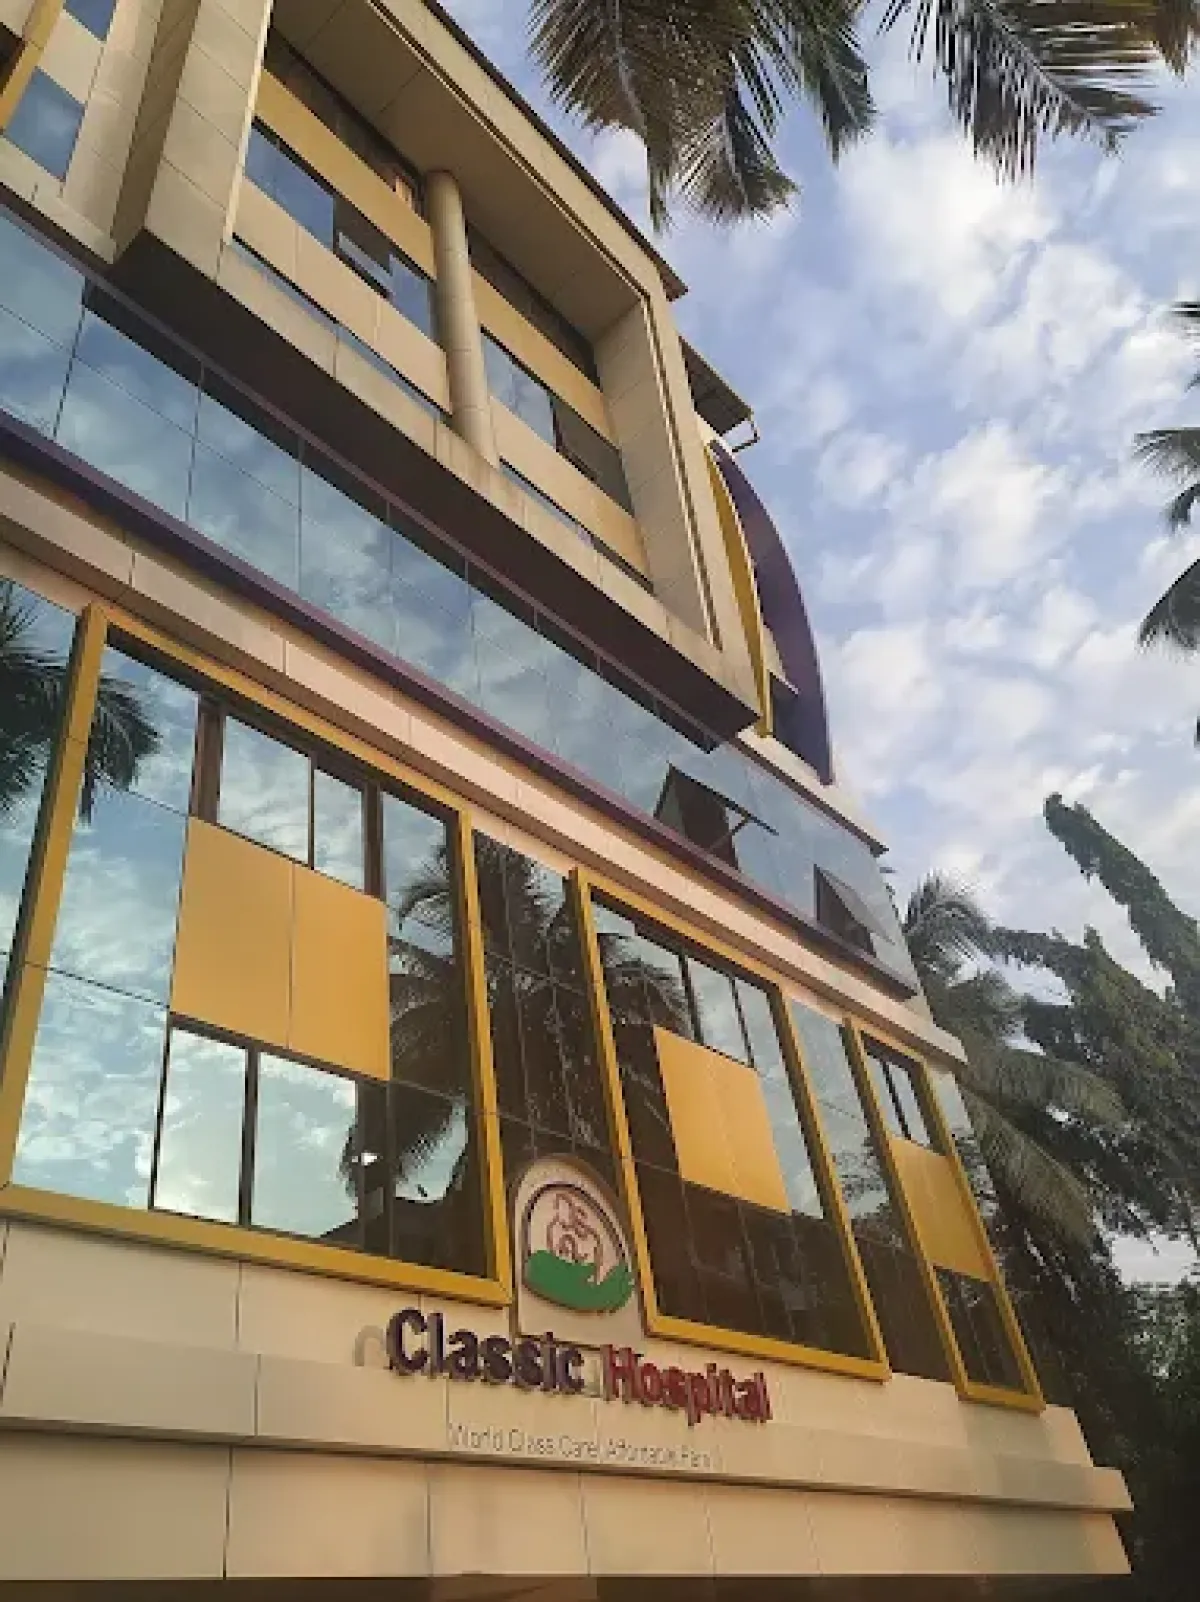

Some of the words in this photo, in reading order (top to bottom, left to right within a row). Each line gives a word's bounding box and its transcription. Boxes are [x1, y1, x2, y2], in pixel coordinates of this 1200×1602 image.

[386, 1307, 584, 1395] Classic
[600, 1344, 773, 1426] Hospital
[447, 1423, 503, 1452] World
[509, 1428, 554, 1455] Class
